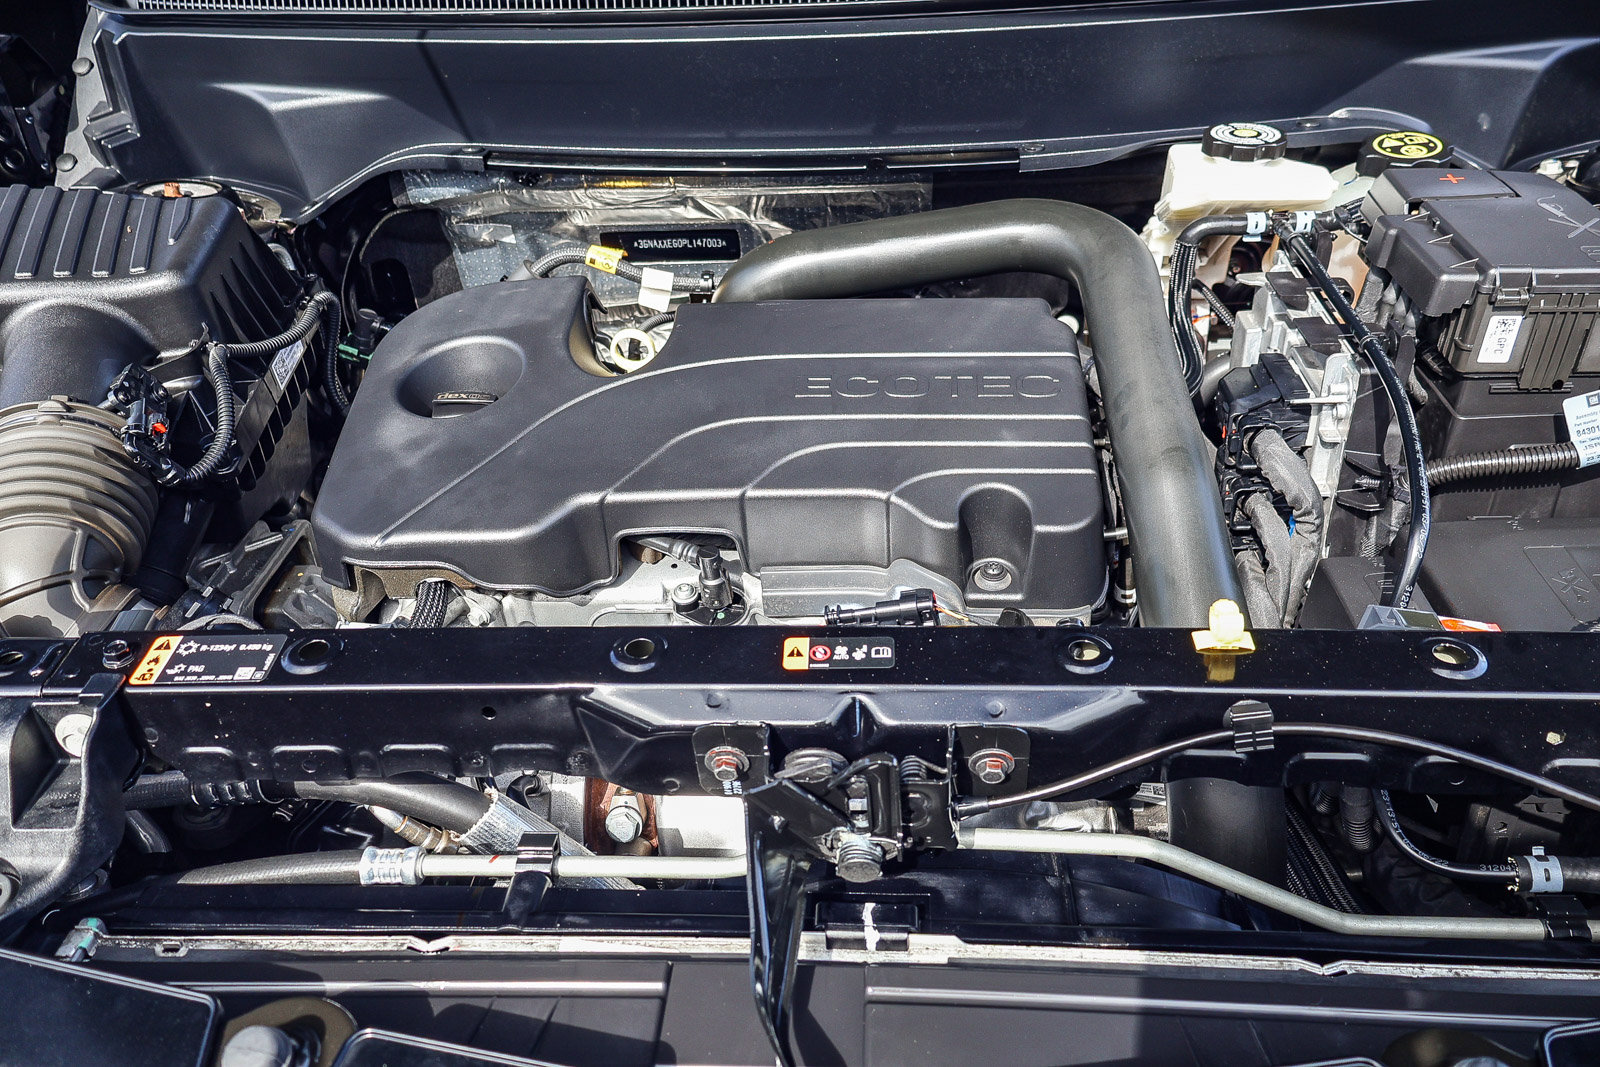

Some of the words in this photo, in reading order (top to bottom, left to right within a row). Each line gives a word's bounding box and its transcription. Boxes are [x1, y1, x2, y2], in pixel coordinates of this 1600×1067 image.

[794, 375, 1063, 398] ECOTEC
[1399, 584, 1413, 609] 3120
[187, 664, 206, 673] PAG
